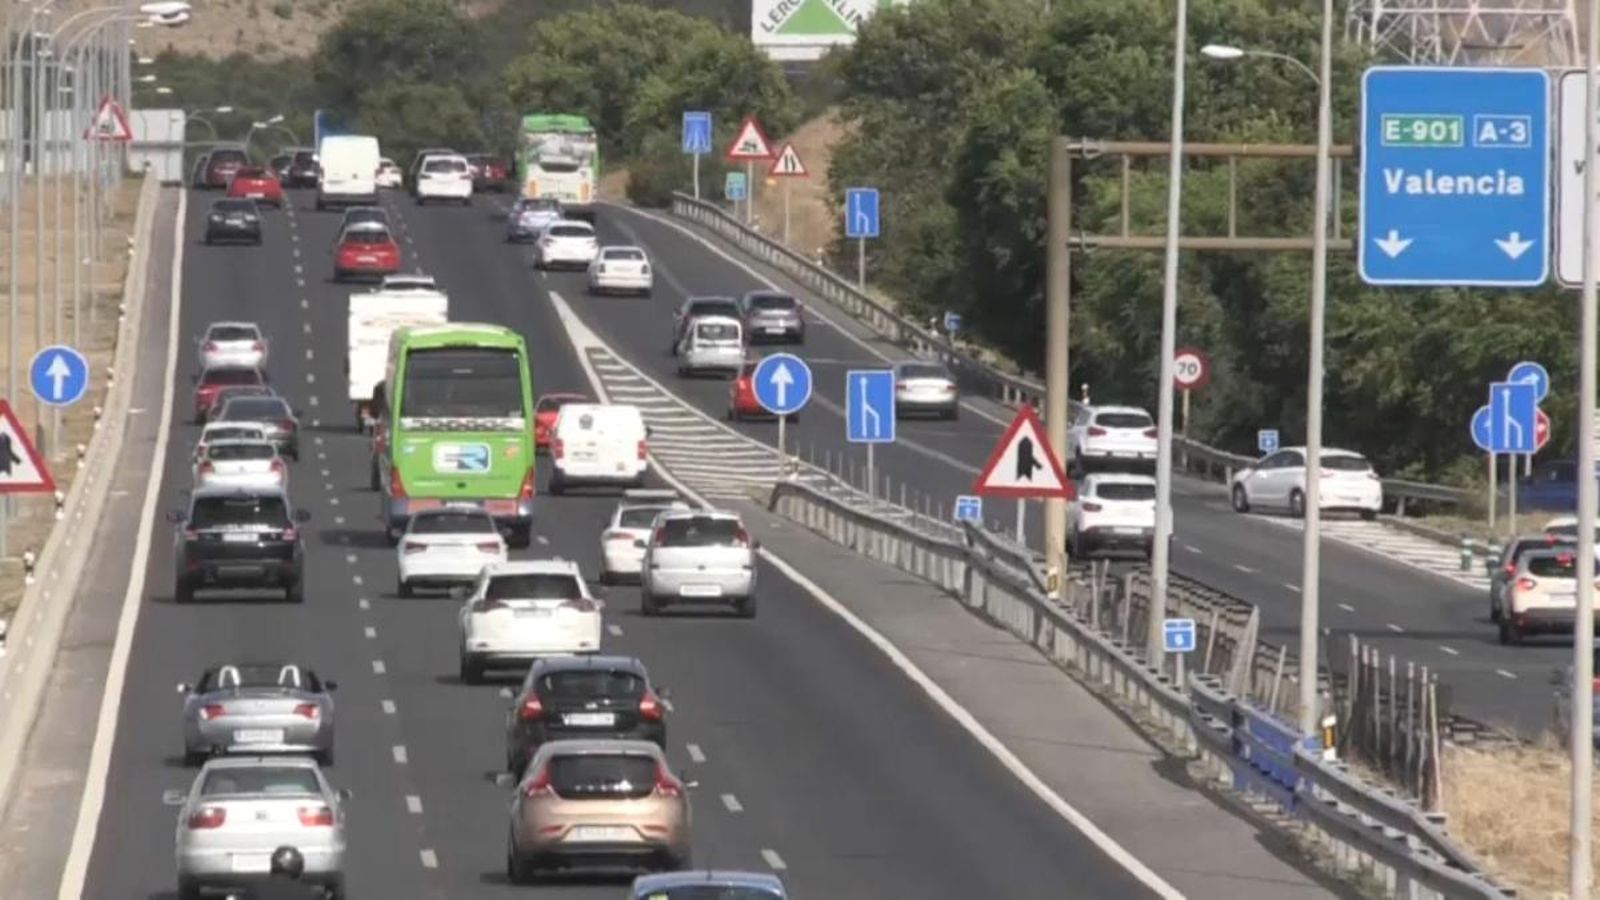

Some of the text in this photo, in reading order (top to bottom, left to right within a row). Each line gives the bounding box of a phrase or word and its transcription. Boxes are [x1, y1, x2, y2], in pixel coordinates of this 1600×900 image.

[1384, 119, 1460, 142] E-901
[1479, 121, 1527, 142] A-3
[1383, 168, 1525, 195] Valencia
[1177, 361, 1199, 376] 70
